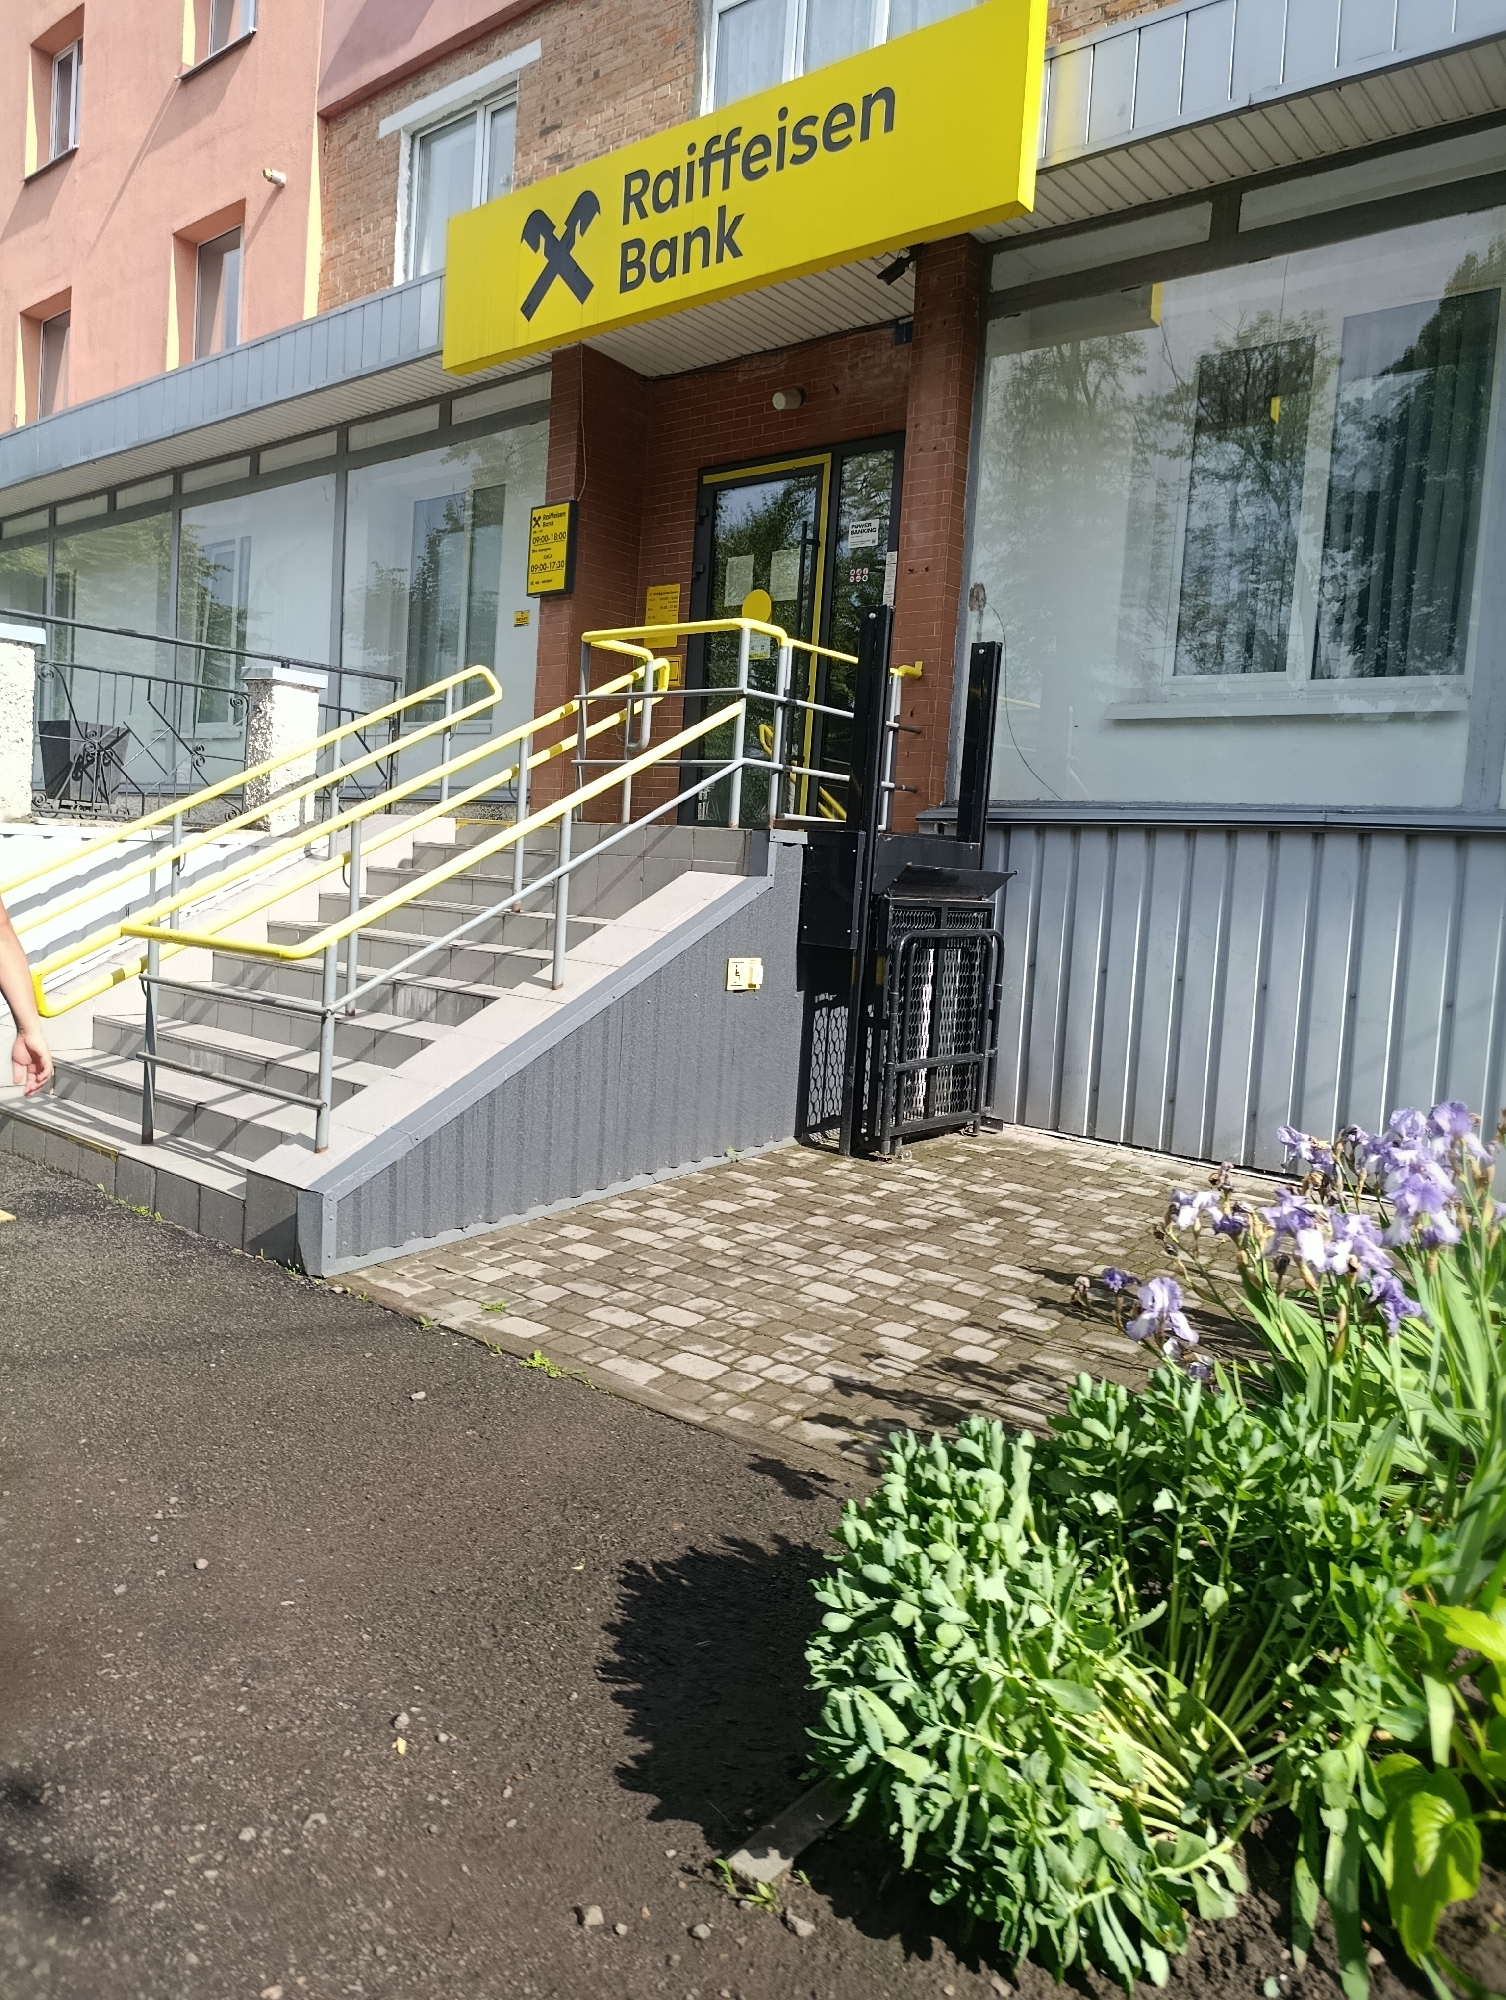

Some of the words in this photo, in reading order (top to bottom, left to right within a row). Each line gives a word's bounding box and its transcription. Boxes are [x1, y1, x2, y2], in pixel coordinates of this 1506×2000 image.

[622, 86, 896, 226] Raiffeisen
[619, 205, 744, 295] Bank
[542, 511, 567, 520] Raiffeisen
[850, 527, 877, 535] BANKING
